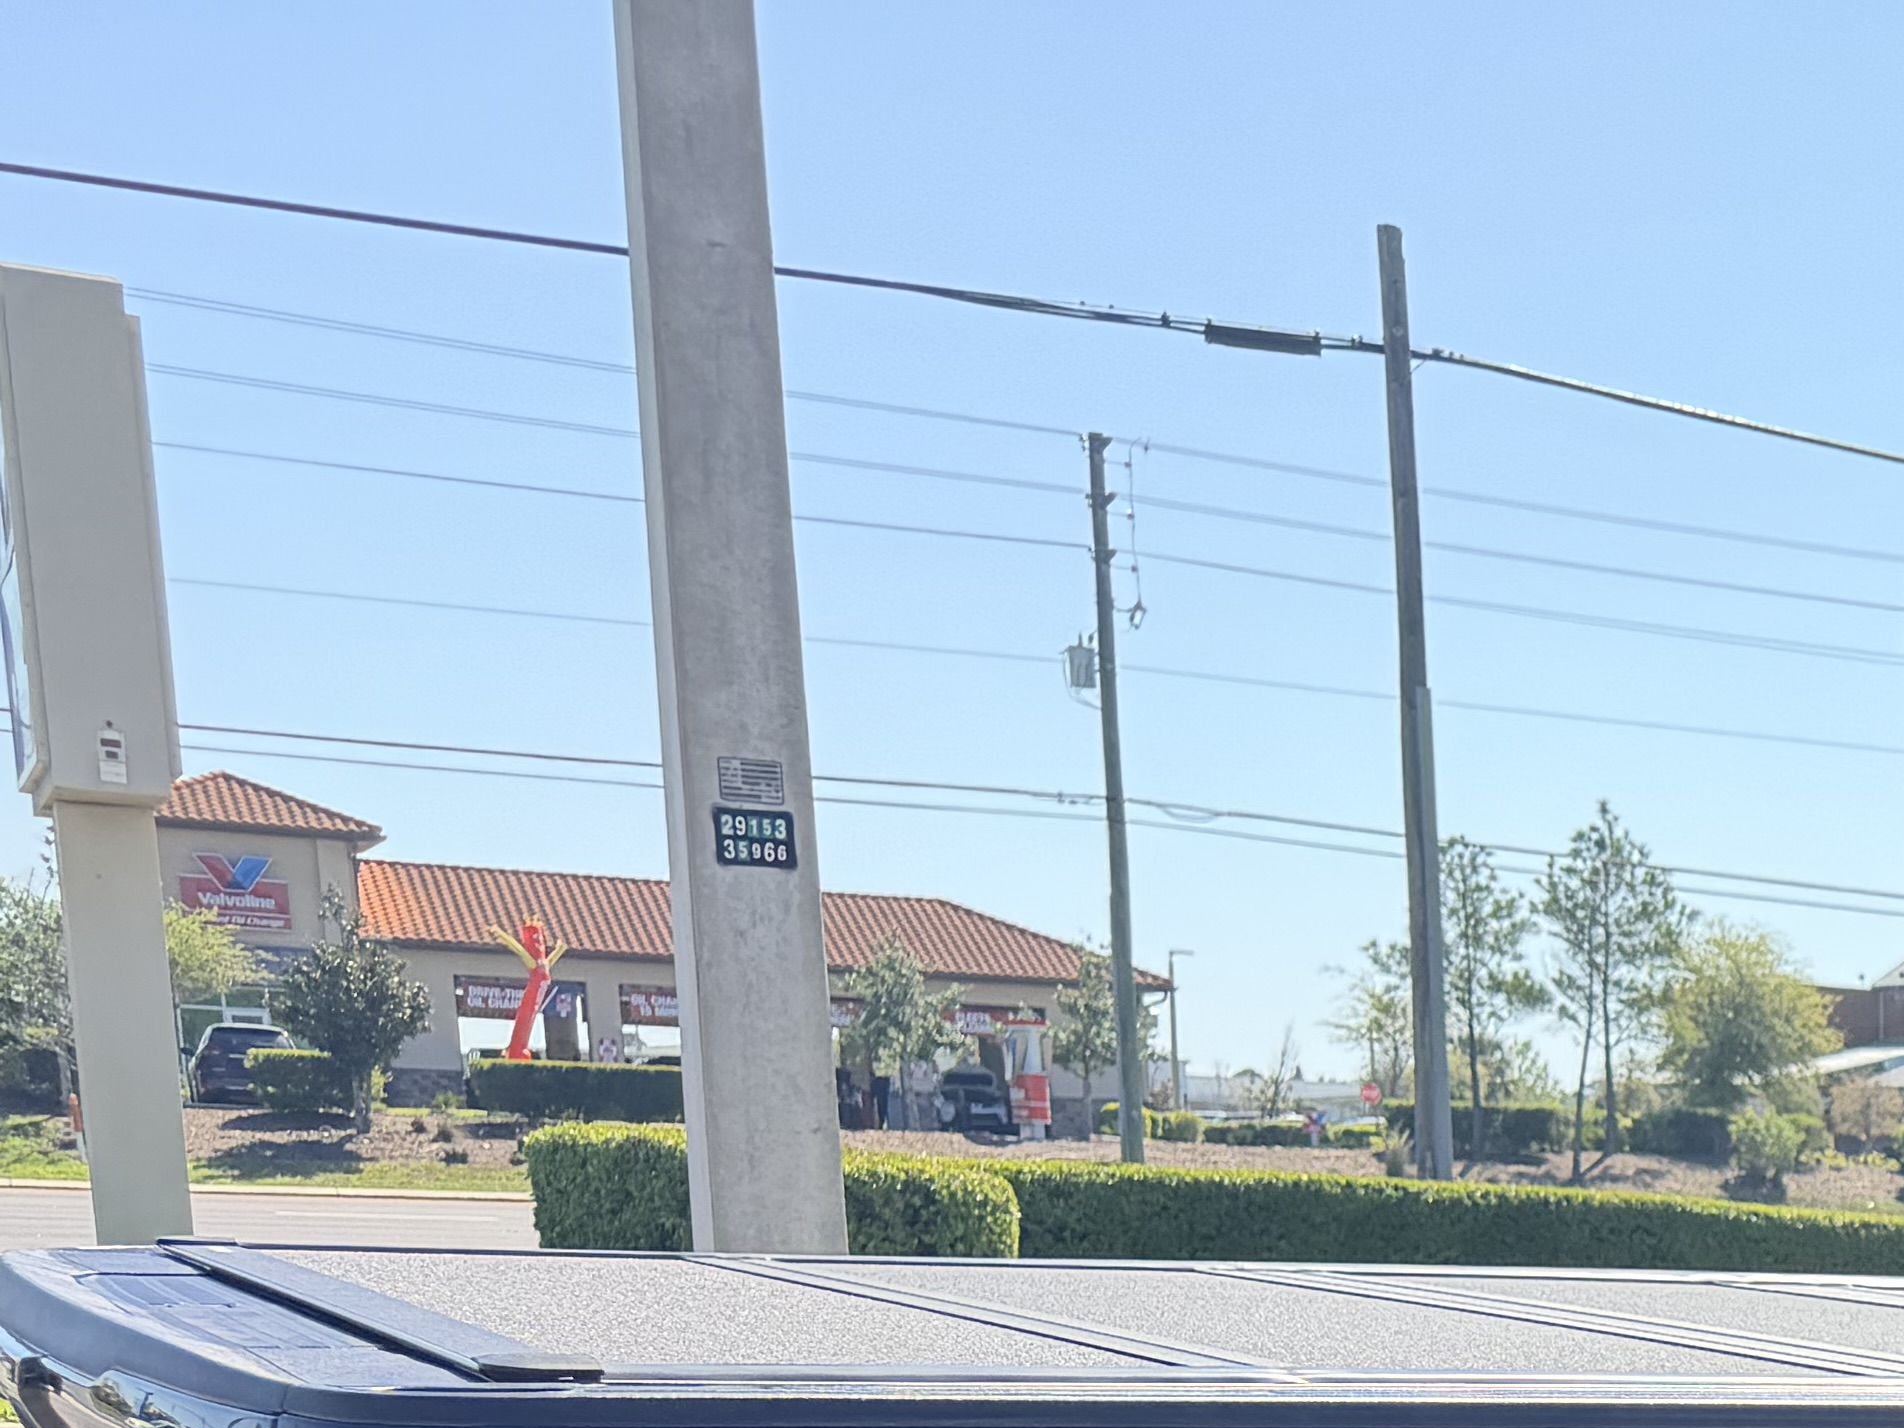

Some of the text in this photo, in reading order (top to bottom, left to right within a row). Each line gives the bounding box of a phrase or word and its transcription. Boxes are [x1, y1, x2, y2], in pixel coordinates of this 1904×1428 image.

[721, 815, 787, 839] 29153
[723, 839, 787, 862] 35966
[197, 892, 276, 909] Valvoline
